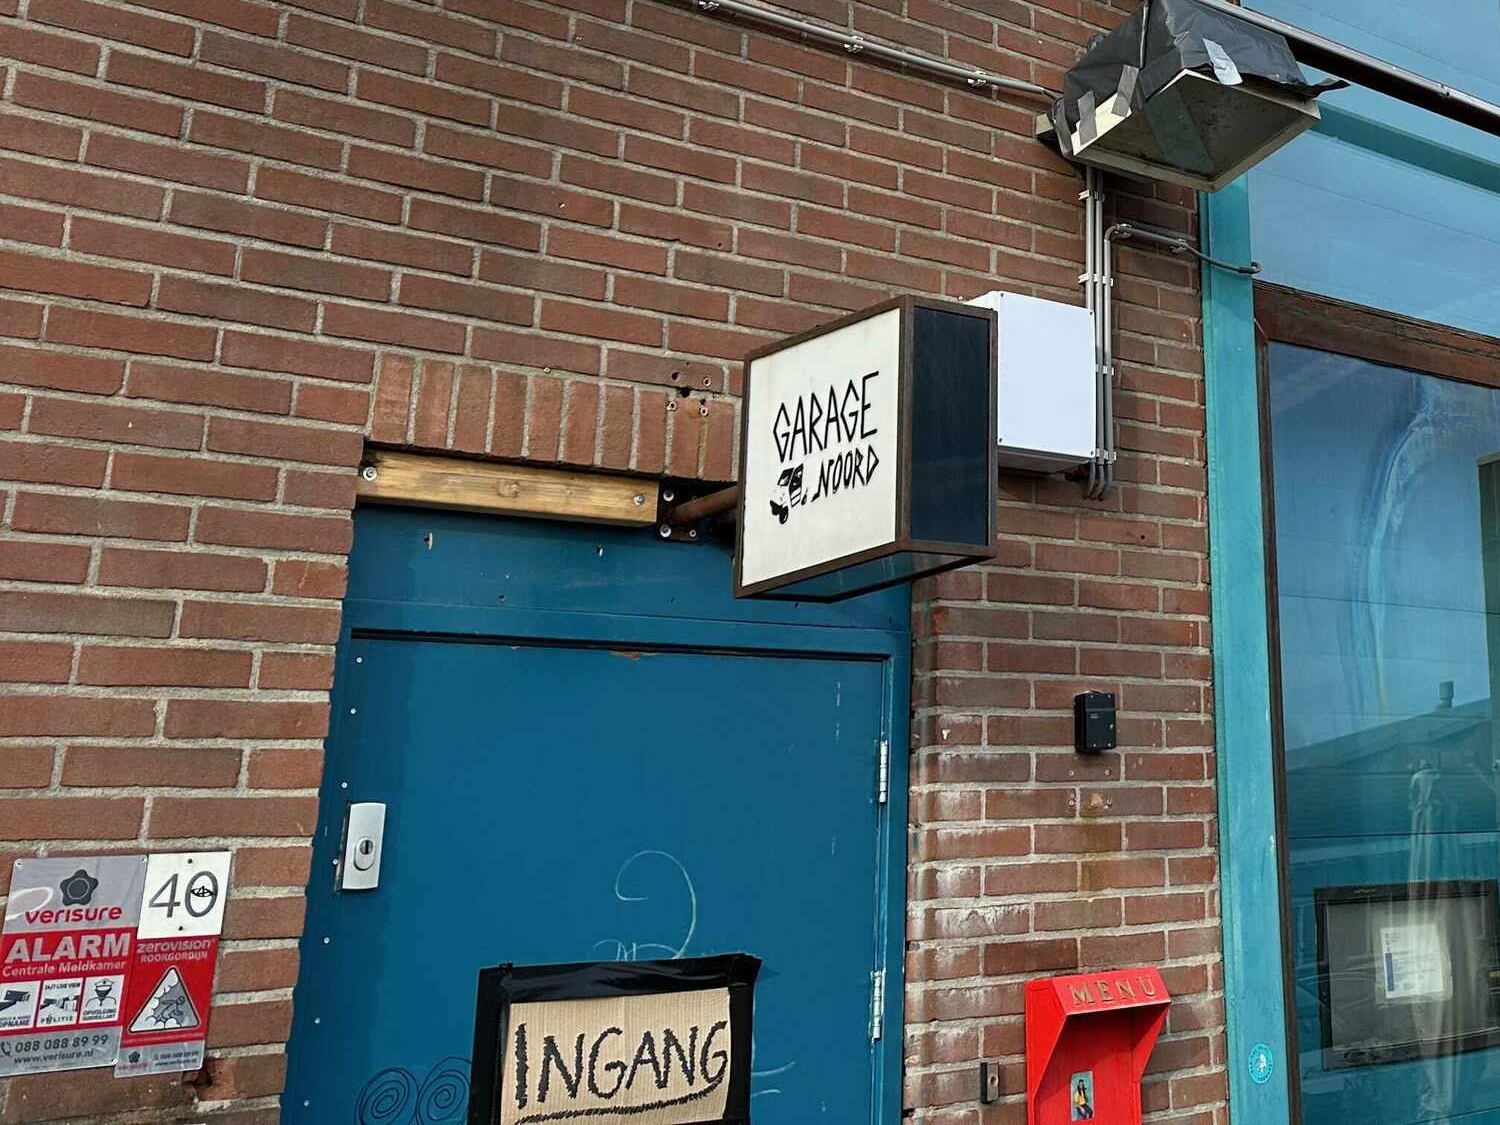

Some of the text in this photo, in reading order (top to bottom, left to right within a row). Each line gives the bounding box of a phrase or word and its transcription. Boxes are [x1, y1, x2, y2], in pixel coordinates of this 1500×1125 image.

[773, 371, 879, 463] GARAGE
[811, 444, 879, 503] NOORD
[148, 871, 219, 918] 40
[25, 906, 122, 925] verisure
[5, 932, 130, 963] ALARM
[2, 961, 127, 977] Centrale Meldkamer
[1069, 976, 1156, 1006] MENU
[15, 1039, 40, 1053] 088
[44, 1038, 69, 1050] 088
[72, 1036, 89, 1048] 89
[92, 1034, 109, 1045] 99
[515, 1020, 728, 1110] INGANG
